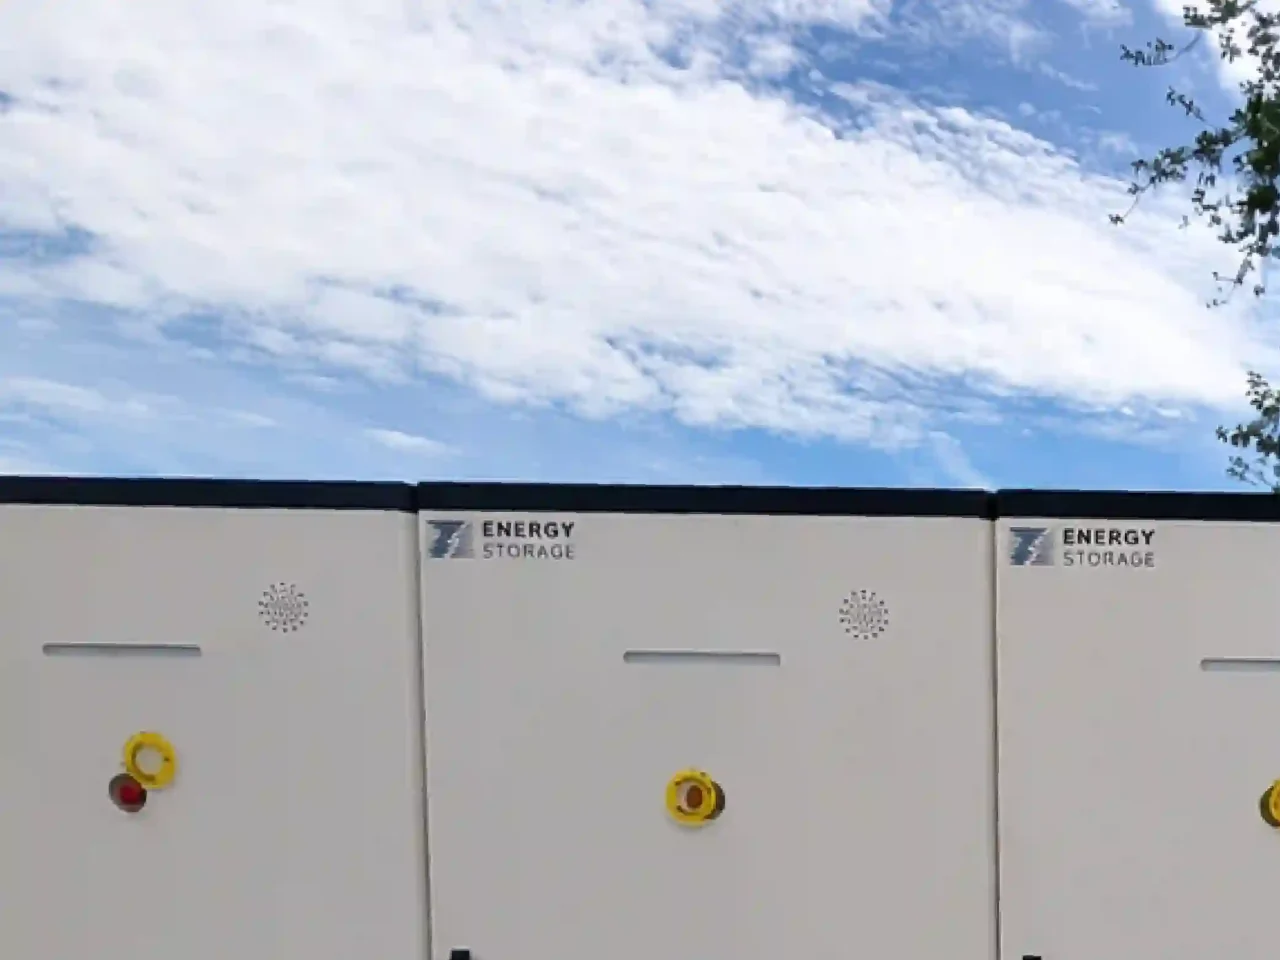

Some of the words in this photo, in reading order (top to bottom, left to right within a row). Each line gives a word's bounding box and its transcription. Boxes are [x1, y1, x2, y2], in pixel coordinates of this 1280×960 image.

[483, 520, 575, 539] ENERGY
[1063, 528, 1156, 546] ENERGY
[482, 543, 575, 560] STORAGE
[1063, 550, 1155, 567] STORAGE
